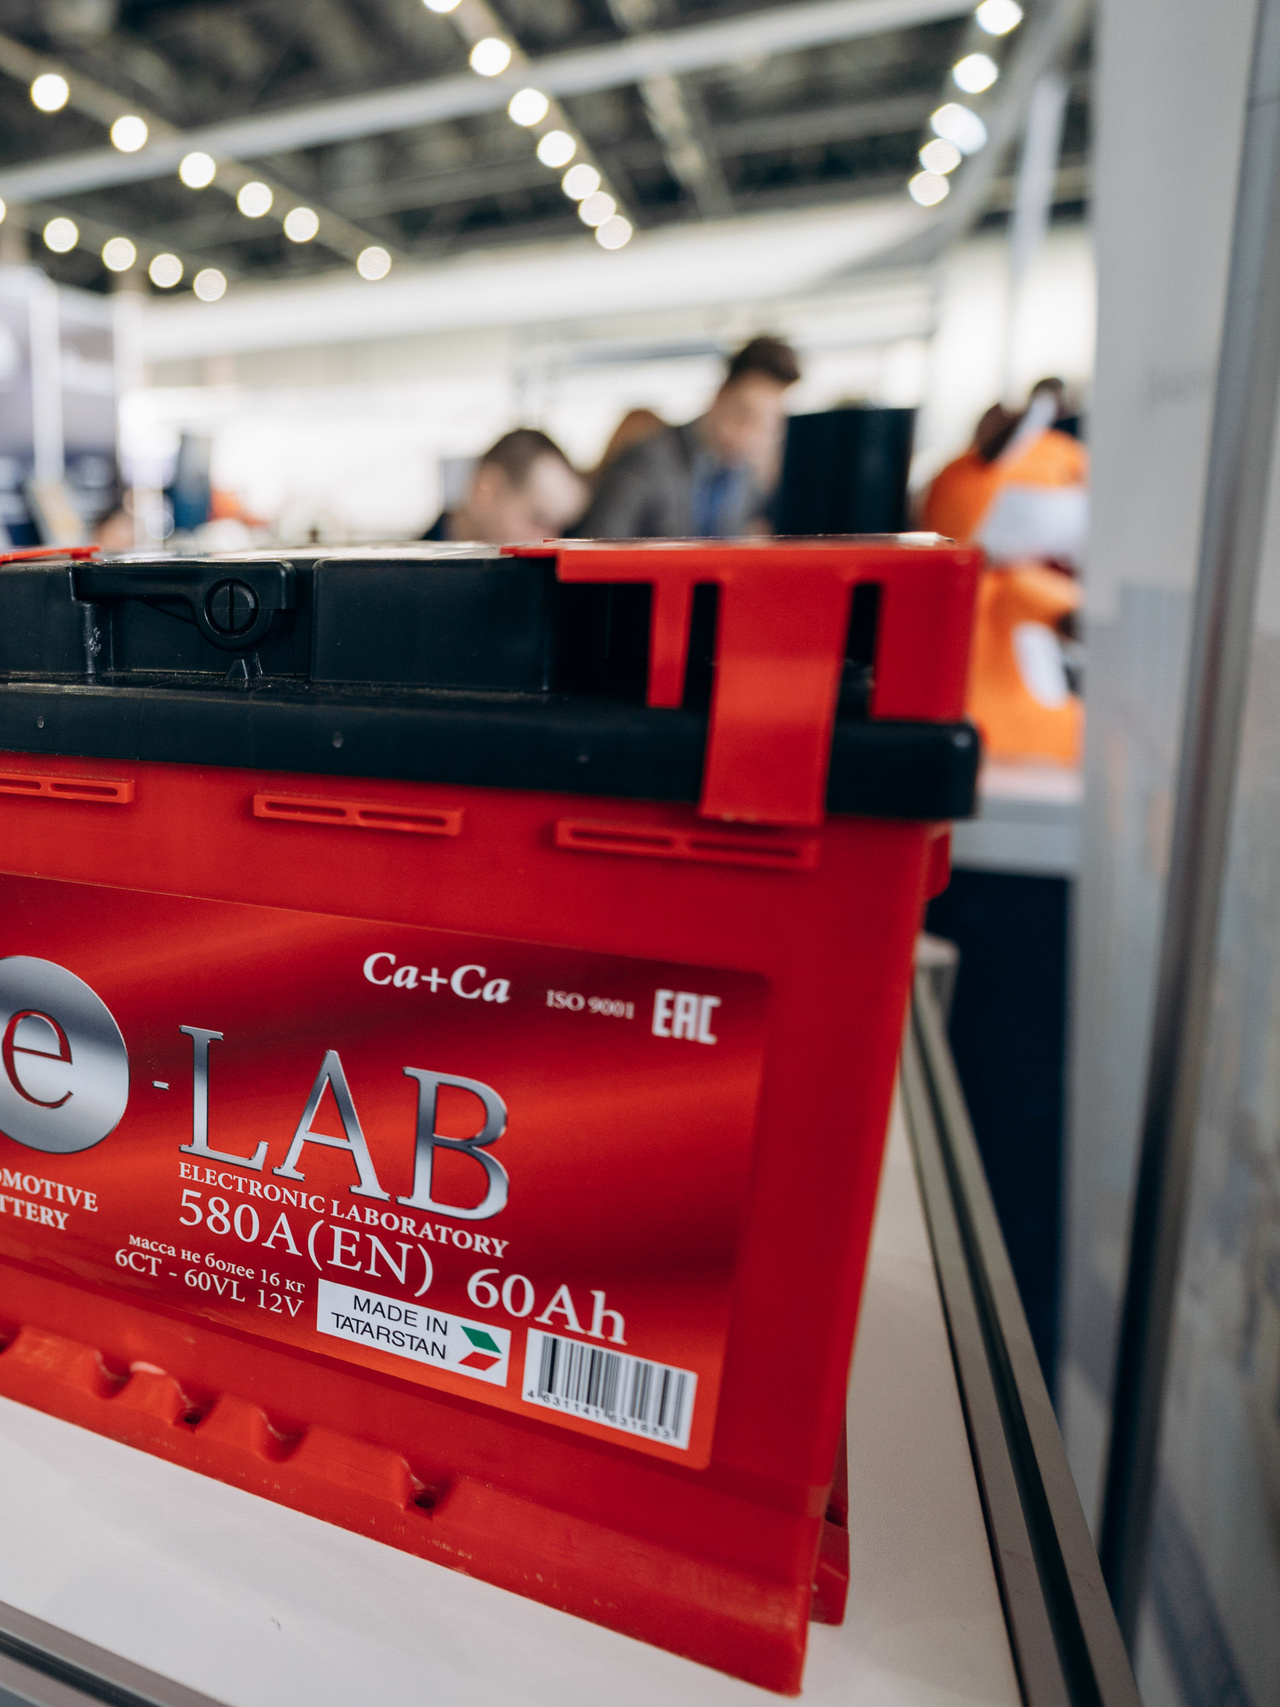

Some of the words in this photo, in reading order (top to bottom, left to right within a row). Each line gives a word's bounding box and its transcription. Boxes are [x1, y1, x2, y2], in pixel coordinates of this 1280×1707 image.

[363, 952, 511, 1004] Ca+Ca
[546, 989, 585, 1011] ISO
[588, 996, 635, 1020] 9001
[178, 1162, 326, 1214] ELECTRONIC
[330, 1199, 509, 1259] LABORATORY
[129, 1234, 177, 1258] масса
[181, 1248, 201, 1264] не
[204, 1252, 255, 1280] более
[261, 1268, 281, 1287] 16
[285, 1278, 306, 1294] кг
[184, 1268, 246, 1303] 60VL
[257, 1289, 305, 1318] 12V
[353, 1294, 417, 1328] MADE
[426, 1315, 449, 1336] IN
[466, 1268, 628, 1346] 60Ah
[331, 1312, 447, 1361] TATARSTAN
